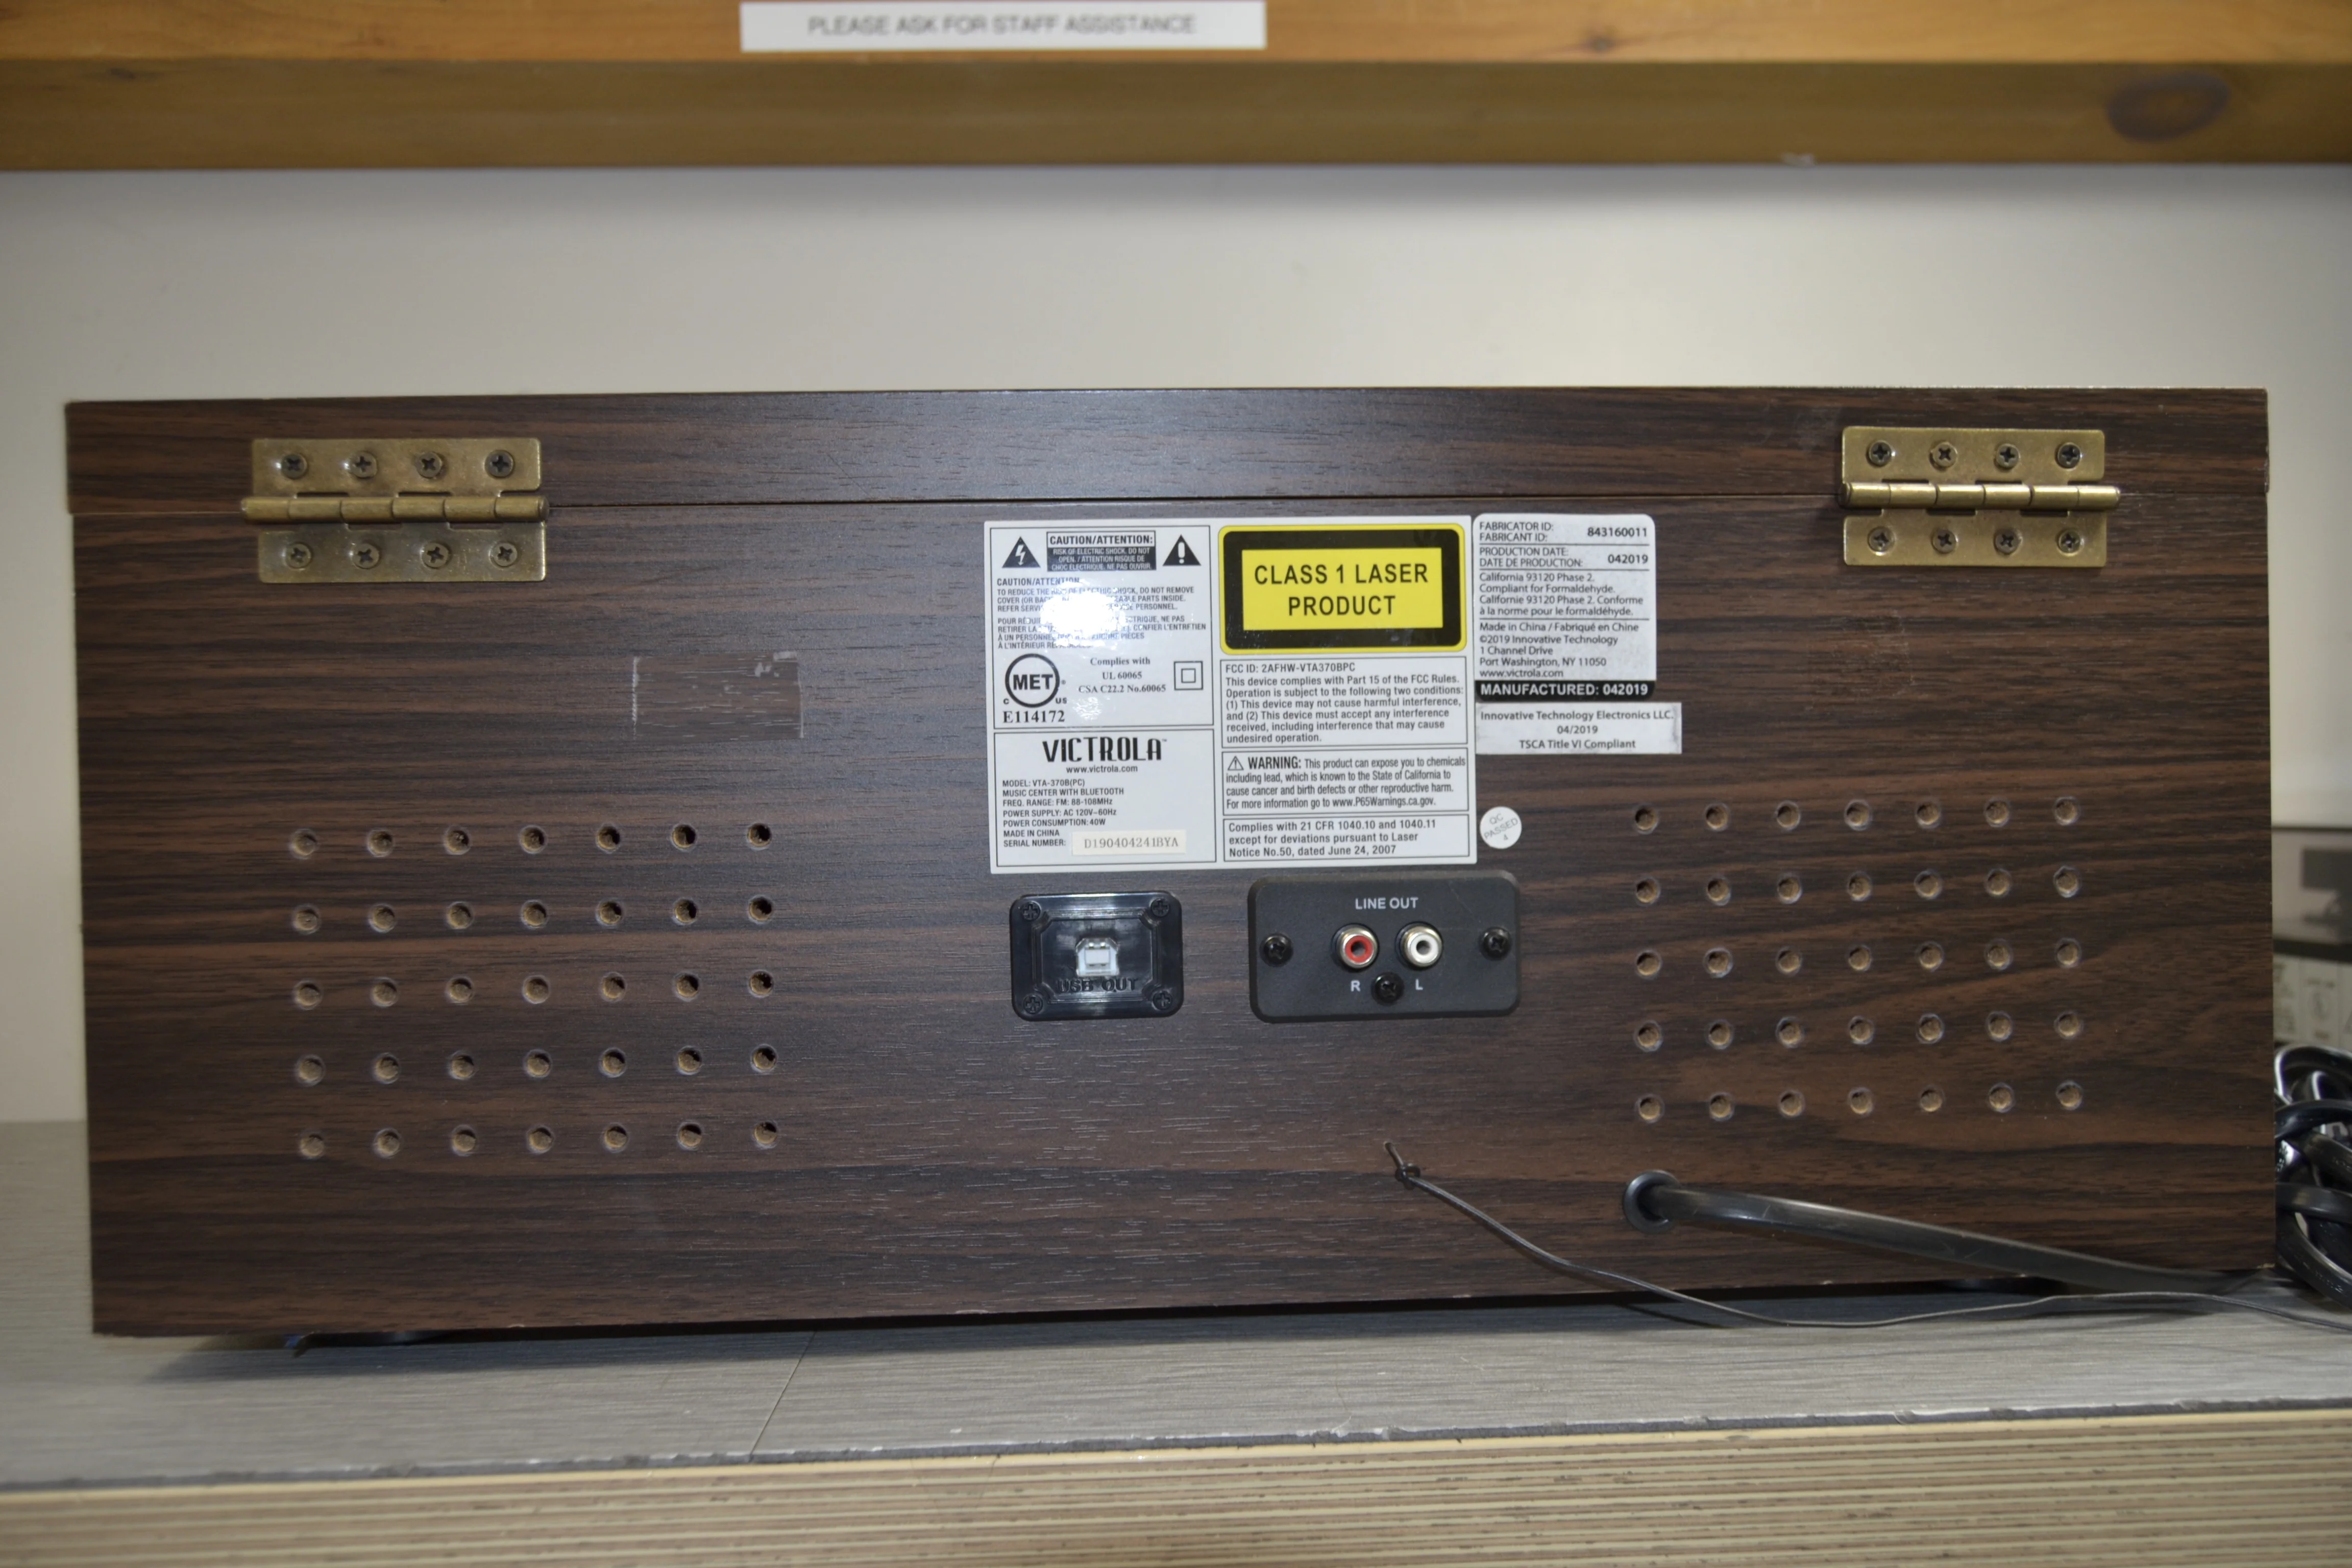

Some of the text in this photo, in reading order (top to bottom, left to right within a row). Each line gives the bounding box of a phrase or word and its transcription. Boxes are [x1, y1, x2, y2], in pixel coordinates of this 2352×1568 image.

[807, 12, 1198, 35] PLEASE ASK FOR STAFF ASSISTANCE
[1479, 522, 1553, 531] FABRICATOR ID:
[1587, 527, 1647, 537] 843160011
[1049, 534, 1153, 545] CAUTION/ATTENTION:
[1479, 532, 1547, 542] FABRICANT ID:
[1105, 547, 1127, 555] SHOCK.
[1479, 547, 1568, 556] PRODUCTION DATE:
[1479, 558, 1583, 568] DATE DE PRODUCTION:
[1607, 554, 1648, 564] 042019
[1254, 563, 1428, 585] CLASS 1 LASER
[1479, 573, 1595, 582] California 93120 Phase 2.
[1479, 583, 1615, 594] Compliant for Formaldehyde.
[1288, 595, 1395, 616] PRODUCT
[1479, 622, 1506, 631] Made
[1508, 623, 1517, 631] in
[1519, 622, 1546, 631] China
[1548, 623, 1552, 631] /
[1554, 622, 1596, 632] Fabriqué
[1611, 622, 1639, 631] Chine
[1512, 635, 1561, 644] Innovative
[1563, 635, 1618, 645] Technology
[1481, 646, 1553, 655] 1 Channel Drive
[1090, 656, 1150, 667] Complies with
[1479, 657, 1606, 668] Port Washington, NY 11050
[1226, 662, 1355, 673] FCC ID: 2AFHW-VTA370BPC
[1479, 669, 1563, 677] www.victrola.com
[1117, 671, 1142, 679] 60065
[1226, 674, 1459, 687] This device complies with Part 15 of the FCC Rules.
[1013, 674, 1053, 690] MET
[1078, 684, 1166, 693] CSA C22.2 No.60065
[1481, 683, 1648, 695] MANUFACTURED: 042019
[1003, 709, 1065, 723] E114172
[1481, 709, 1675, 722] Innovative Technology Electronics LLC.
[1557, 725, 1598, 734] 04/2019
[1043, 737, 1161, 762] VICTROLA
[1519, 739, 1635, 750] TSCA Title VI Compliant
[1066, 764, 1138, 773] www.victrola.com
[1247, 756, 1465, 770] WARNING: This product can expose you to chemicals
[1032, 778, 1085, 788] VTA-370B(PC)
[1028, 789, 1057, 797] CENTER
[1080, 787, 1124, 796] BLUETOOTH
[1002, 799, 1024, 807] FREQ.
[1071, 797, 1112, 805] 88-108MHz
[1032, 818, 1088, 826] CONSUMPTION:
[1489, 813, 1503, 824] QC
[1229, 819, 1435, 833] Complies with 21 CFR 1040.10 and 1040.11
[1484, 818, 1518, 840] PASSED
[1003, 839, 1030, 847] SERIAL
[1229, 831, 1418, 845] except for deviations pursuant to Laser
[1229, 844, 1396, 857] Notice No.50, dated June 24, 2007
[1355, 897, 1418, 910] LINE OUT
[1058, 977, 1138, 993] USB OUT
[1351, 979, 1424, 992] R L
